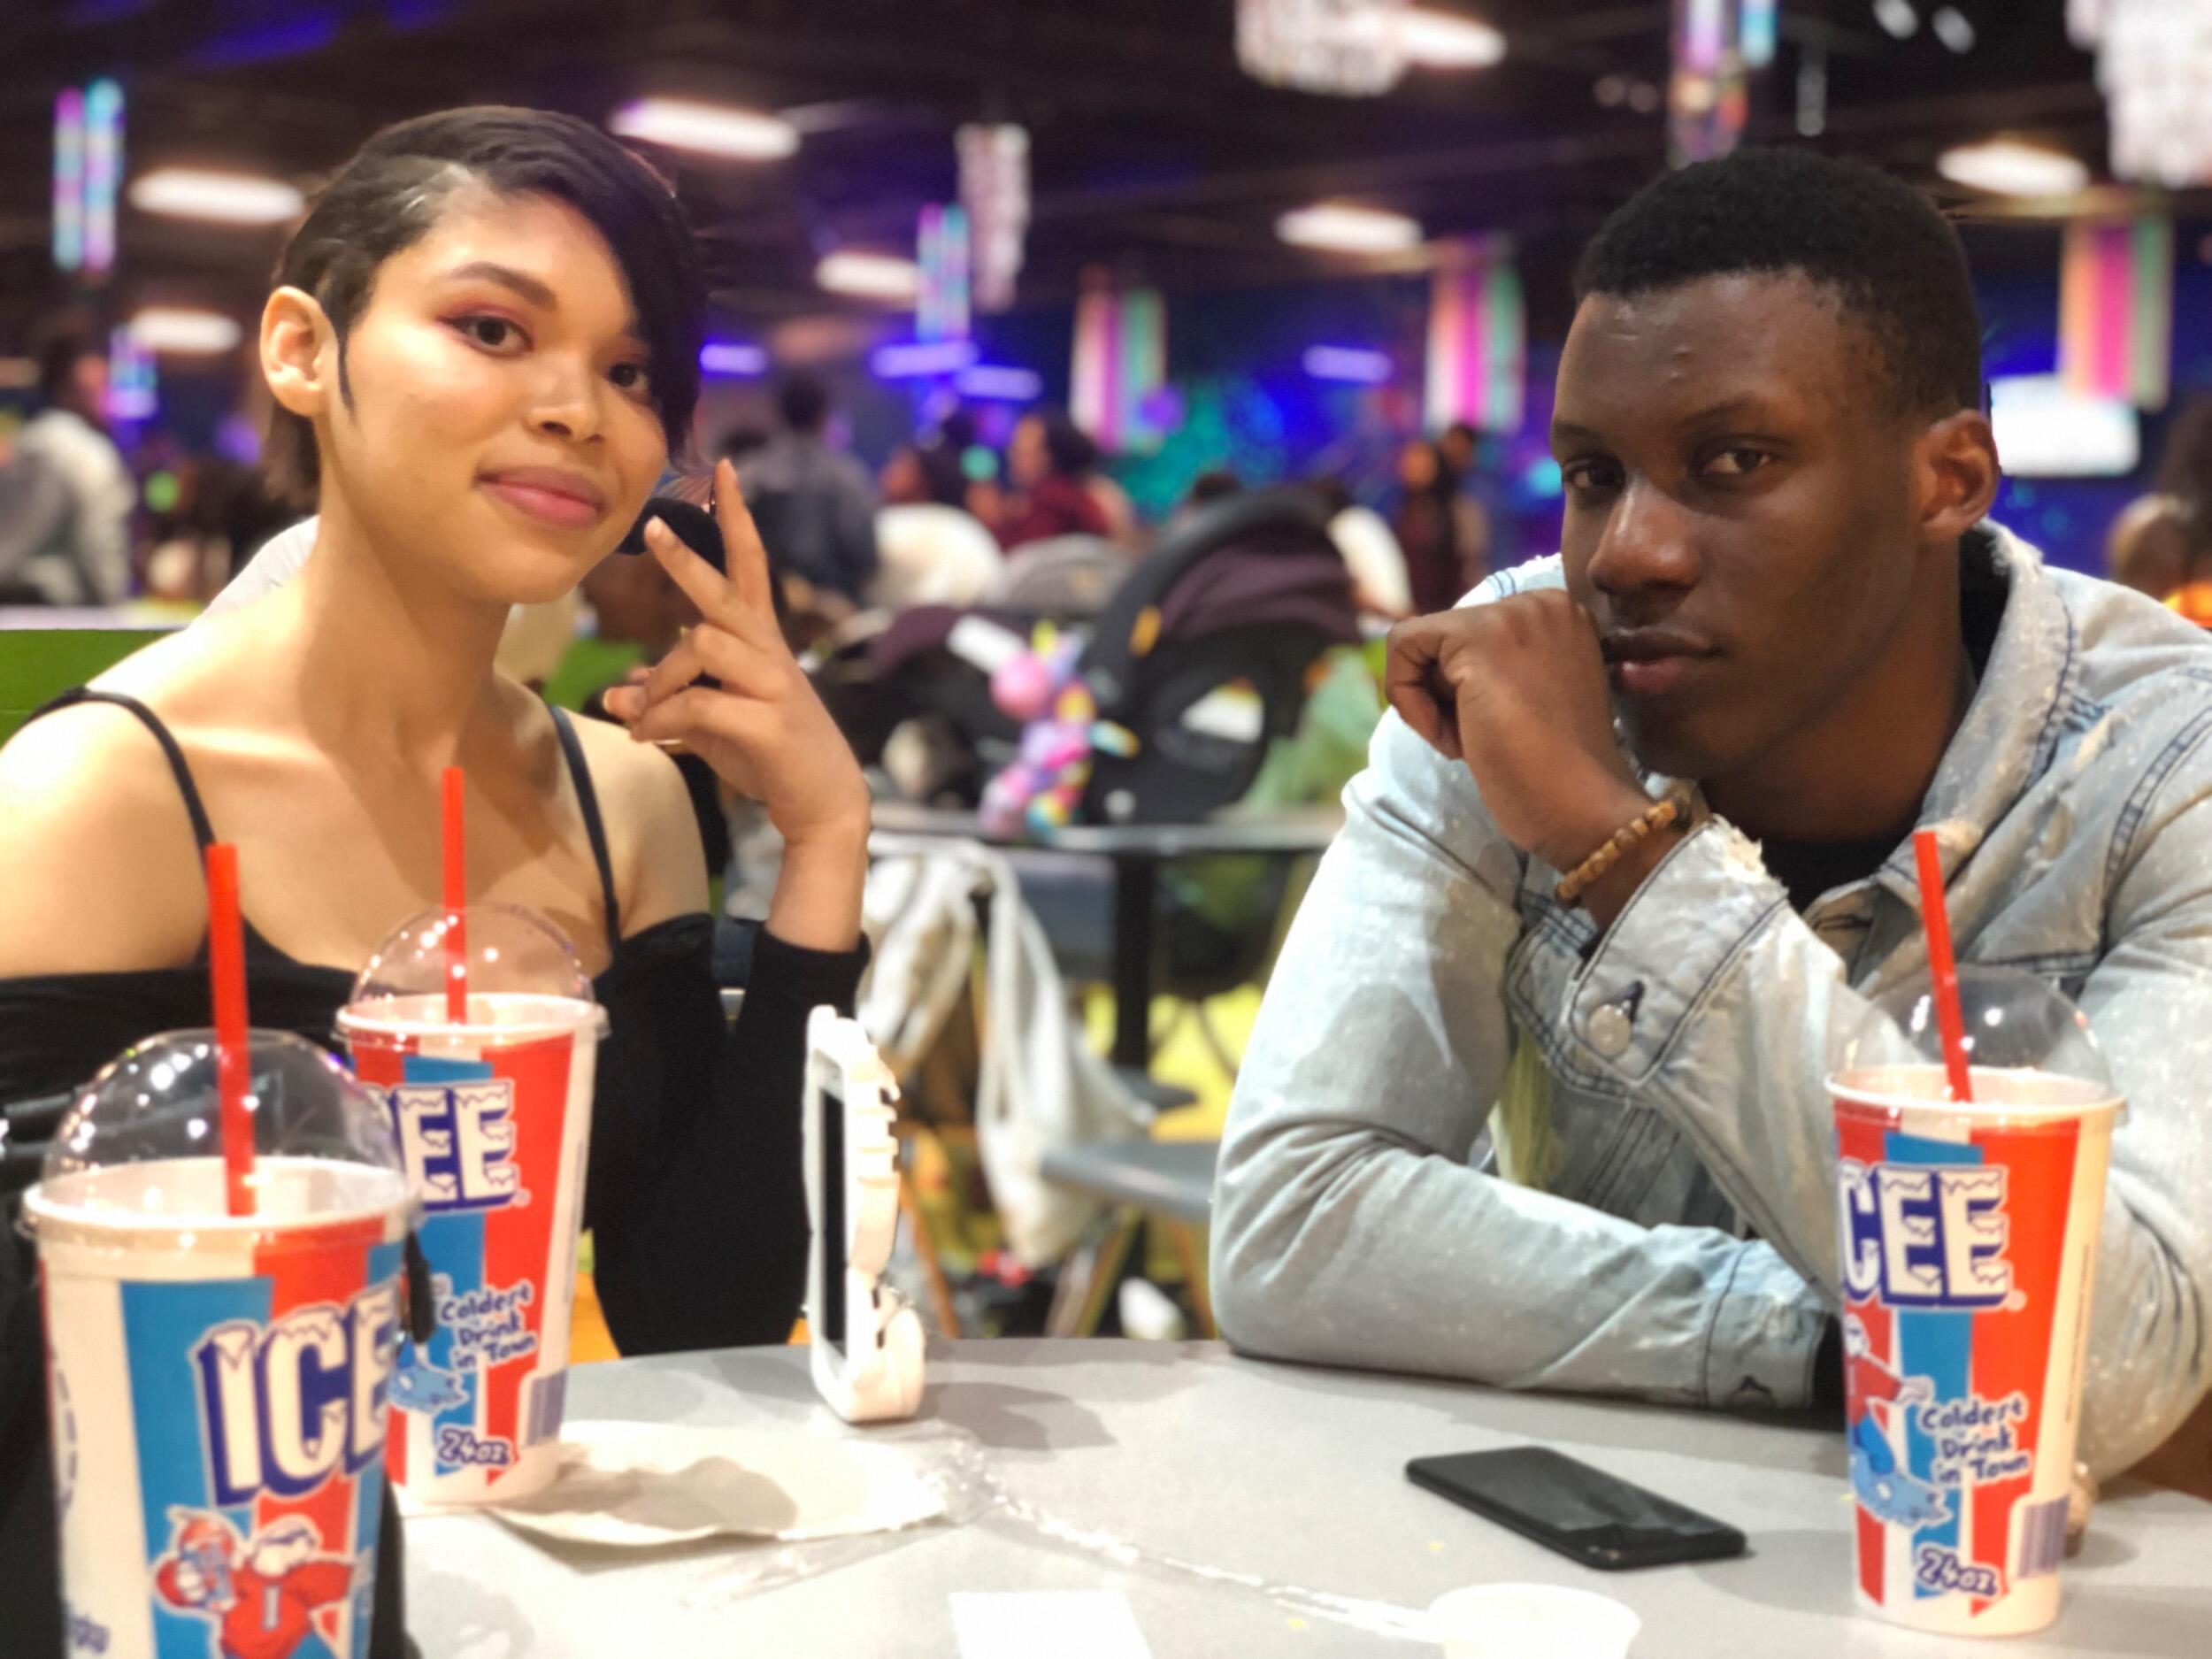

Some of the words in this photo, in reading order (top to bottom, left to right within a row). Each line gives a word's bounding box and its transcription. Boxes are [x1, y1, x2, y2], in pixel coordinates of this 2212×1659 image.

[368, 1083, 515, 1210] EE
[1941, 1425, 2011, 1459] Drink
[1936, 1462, 1962, 1483] in
[1970, 1455, 2029, 1479] Town
